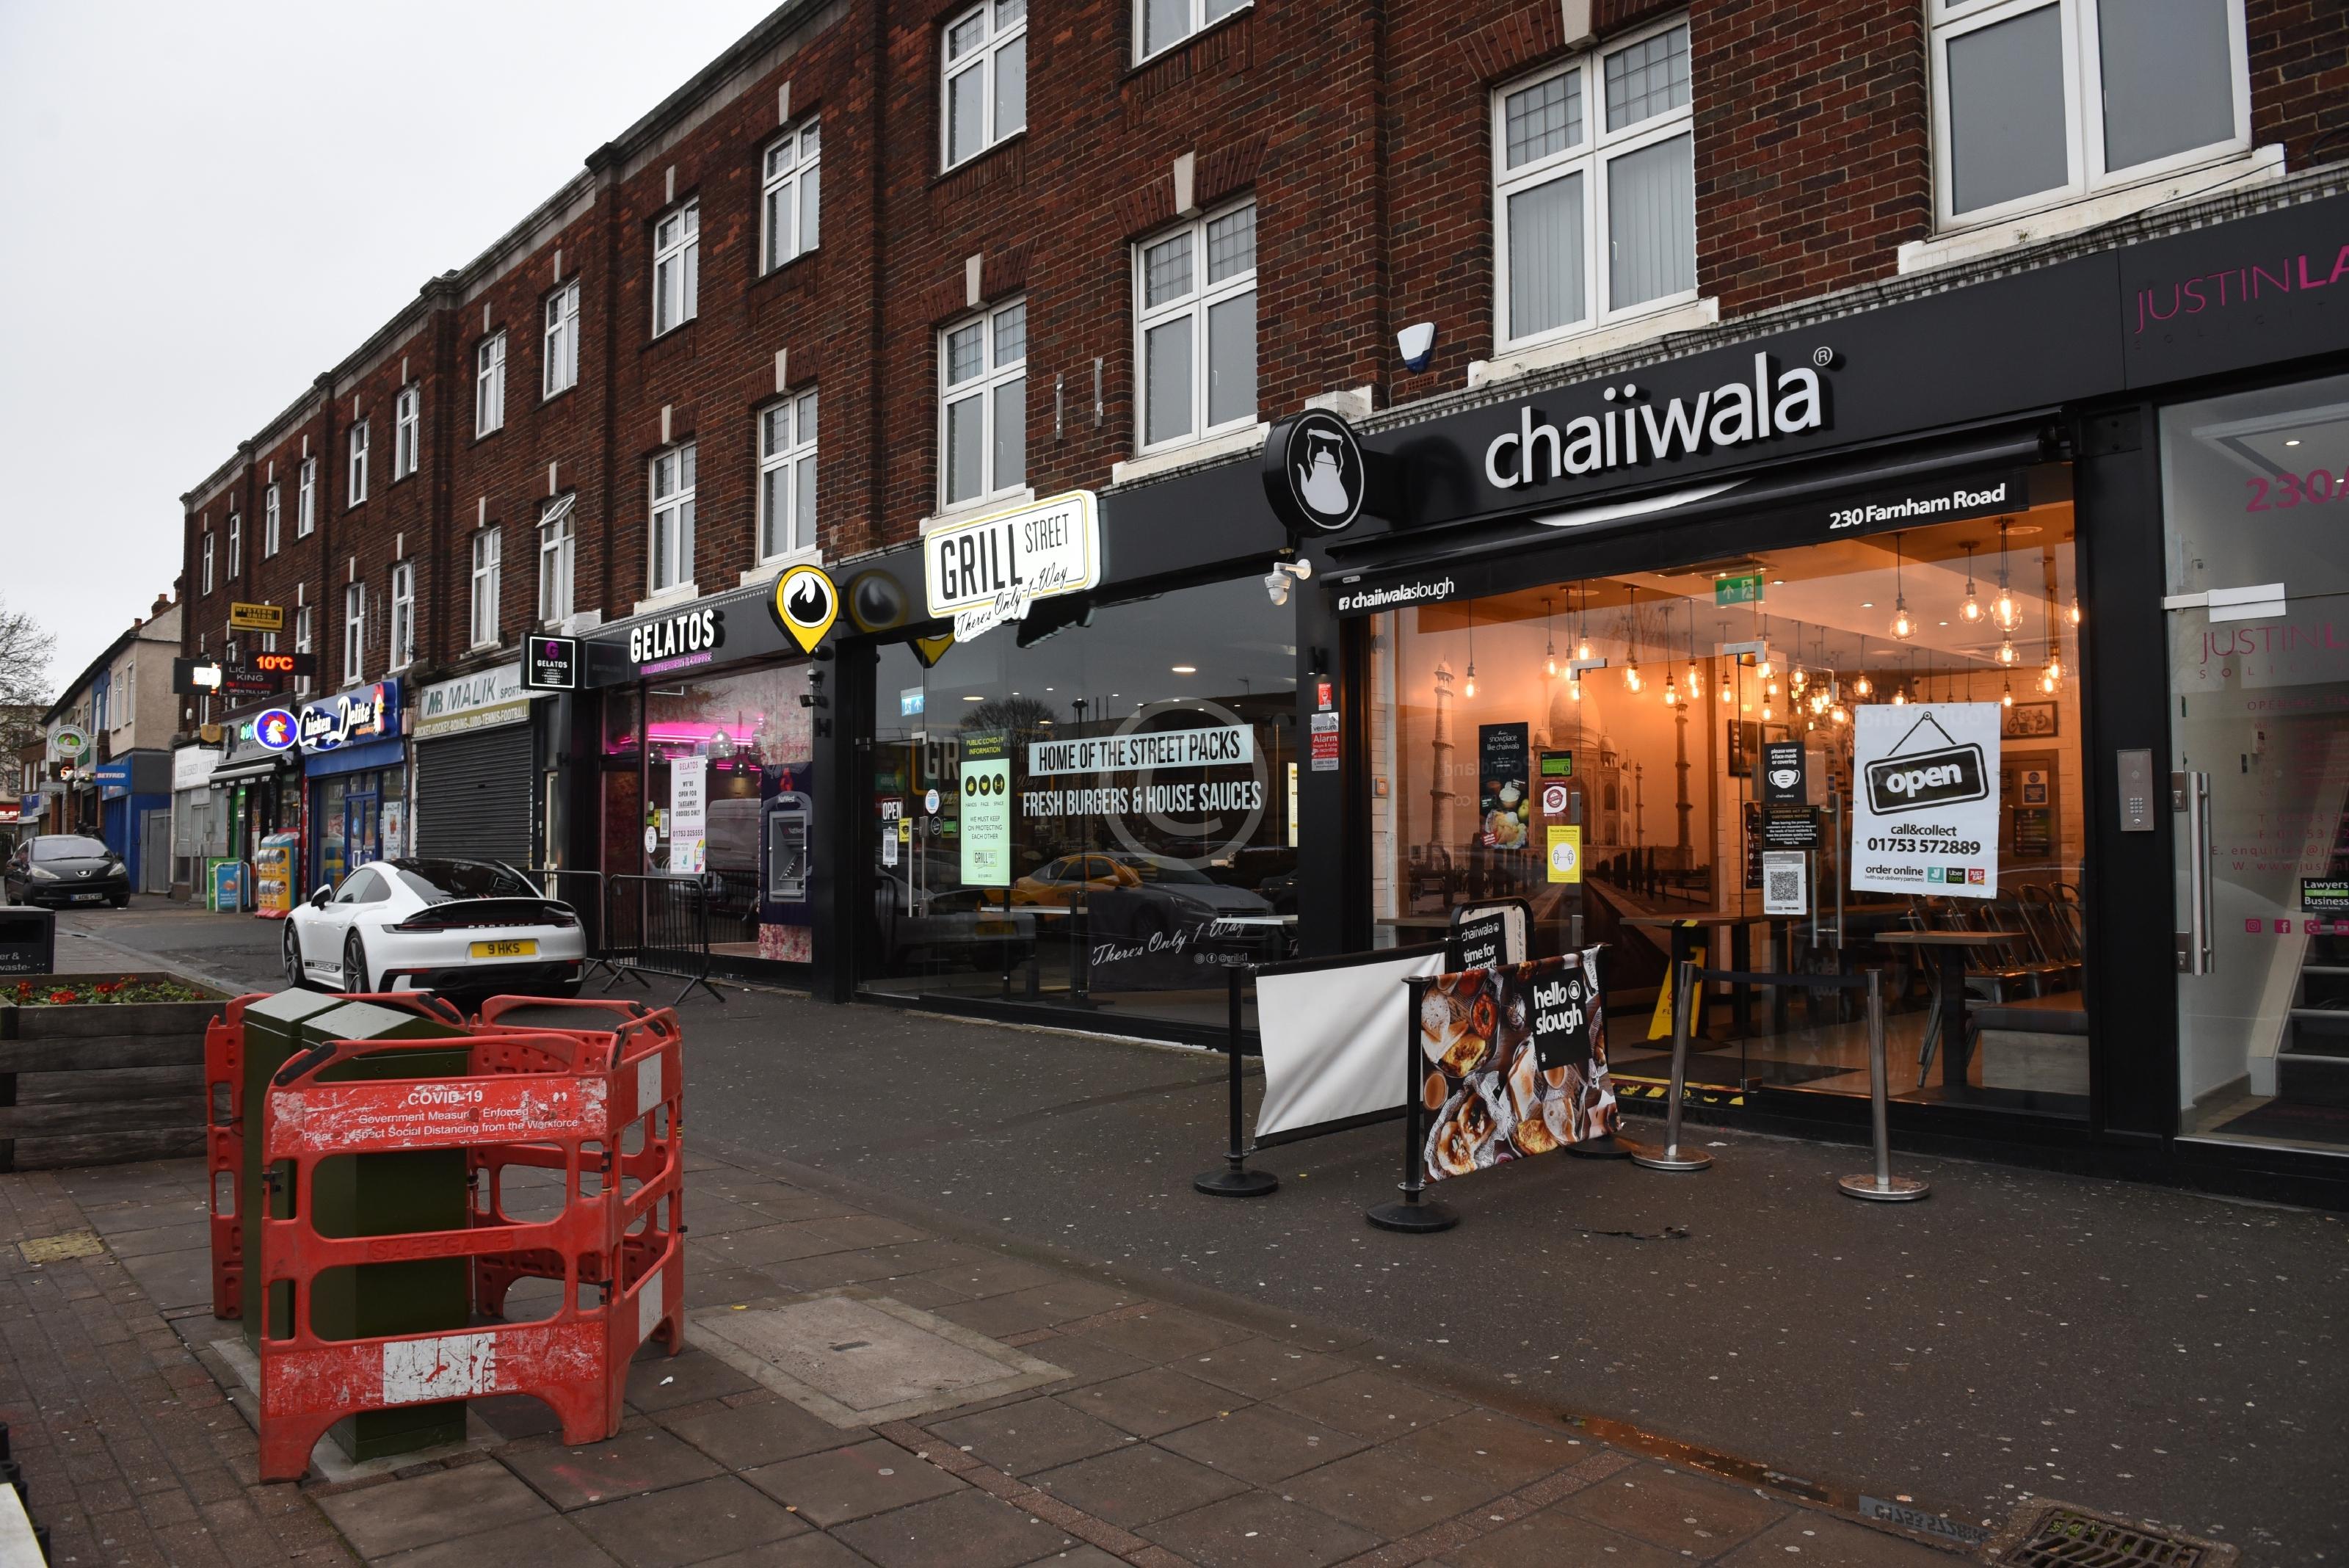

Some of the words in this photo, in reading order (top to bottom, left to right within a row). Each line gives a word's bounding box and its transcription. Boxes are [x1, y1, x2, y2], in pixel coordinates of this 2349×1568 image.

[1829, 508, 1864, 529] 230
[1866, 498, 1950, 523] Farnham
[1954, 483, 2005, 509] Road
[940, 523, 1023, 600] GRILL
[1025, 514, 1069, 553] STREET
[956, 610, 991, 636] There's
[995, 586, 1022, 614] Only
[1027, 577, 1034, 598] 1
[1039, 562, 1067, 592] Way
[1352, 577, 1454, 609] chaiiwalaslough
[631, 609, 714, 663] GELATOS
[537, 660, 567, 669] GELATOS
[236, 674, 264, 682] KING
[447, 676, 497, 711] MALIK
[299, 706, 331, 747] Chicken
[966, 738, 982, 747] PUBLIC
[982, 737, 1004, 745] COVID-19
[1313, 735, 1337, 743] Alarm
[969, 747, 1001, 755] INFORMATION
[1039, 744, 1075, 772] HOME
[1079, 743, 1095, 769] OF
[1100, 740, 1126, 766] THE
[1130, 736, 1185, 765] STREET
[1189, 730, 1241, 762] PACKS
[679, 761, 699, 771] GELATOS
[1887, 763, 1963, 798] open
[1023, 791, 1063, 817] FRESH
[1067, 787, 1128, 816] BURGERS
[1133, 787, 1142, 813] &
[1146, 783, 1195, 813] HOUSE
[1199, 780, 1261, 810] SAUCES
[882, 802, 901, 820] OPEN
[672, 830, 686, 838] 01753
[1891, 824, 1957, 837] call&collect
[1867, 838, 1916, 852] 01753
[1919, 840, 1981, 855] 572889
[975, 852, 988, 863] GRILL
[1866, 865, 1892, 874] order
[1894, 866, 1923, 876] online
[2304, 881, 2348, 890] Lawyers
[2304, 896, 2349, 905] Business
[1462, 923, 1493, 942] chaiiwala
[12, 952, 20, 960] &
[487, 945, 495, 954] 9
[498, 943, 520, 954] HKS
[1092, 943, 1144, 966] There's
[1149, 929, 1186, 954] Only
[1464, 948, 1483, 963] time
[1483, 943, 1495, 957] for
[1533, 981, 1567, 1009] hello
[1536, 1003, 1583, 1035] slough
[407, 1090, 483, 1106] COVID-19
[358, 1113, 425, 1125] Government
[483, 1107, 529, 1117] Enforced
[388, 1126, 421, 1137] Social
[424, 1123, 479, 1135] Distancing
[482, 1122, 505, 1132] from
[508, 1120, 524, 1130] the
[527, 1119, 578, 1130] Workforce
